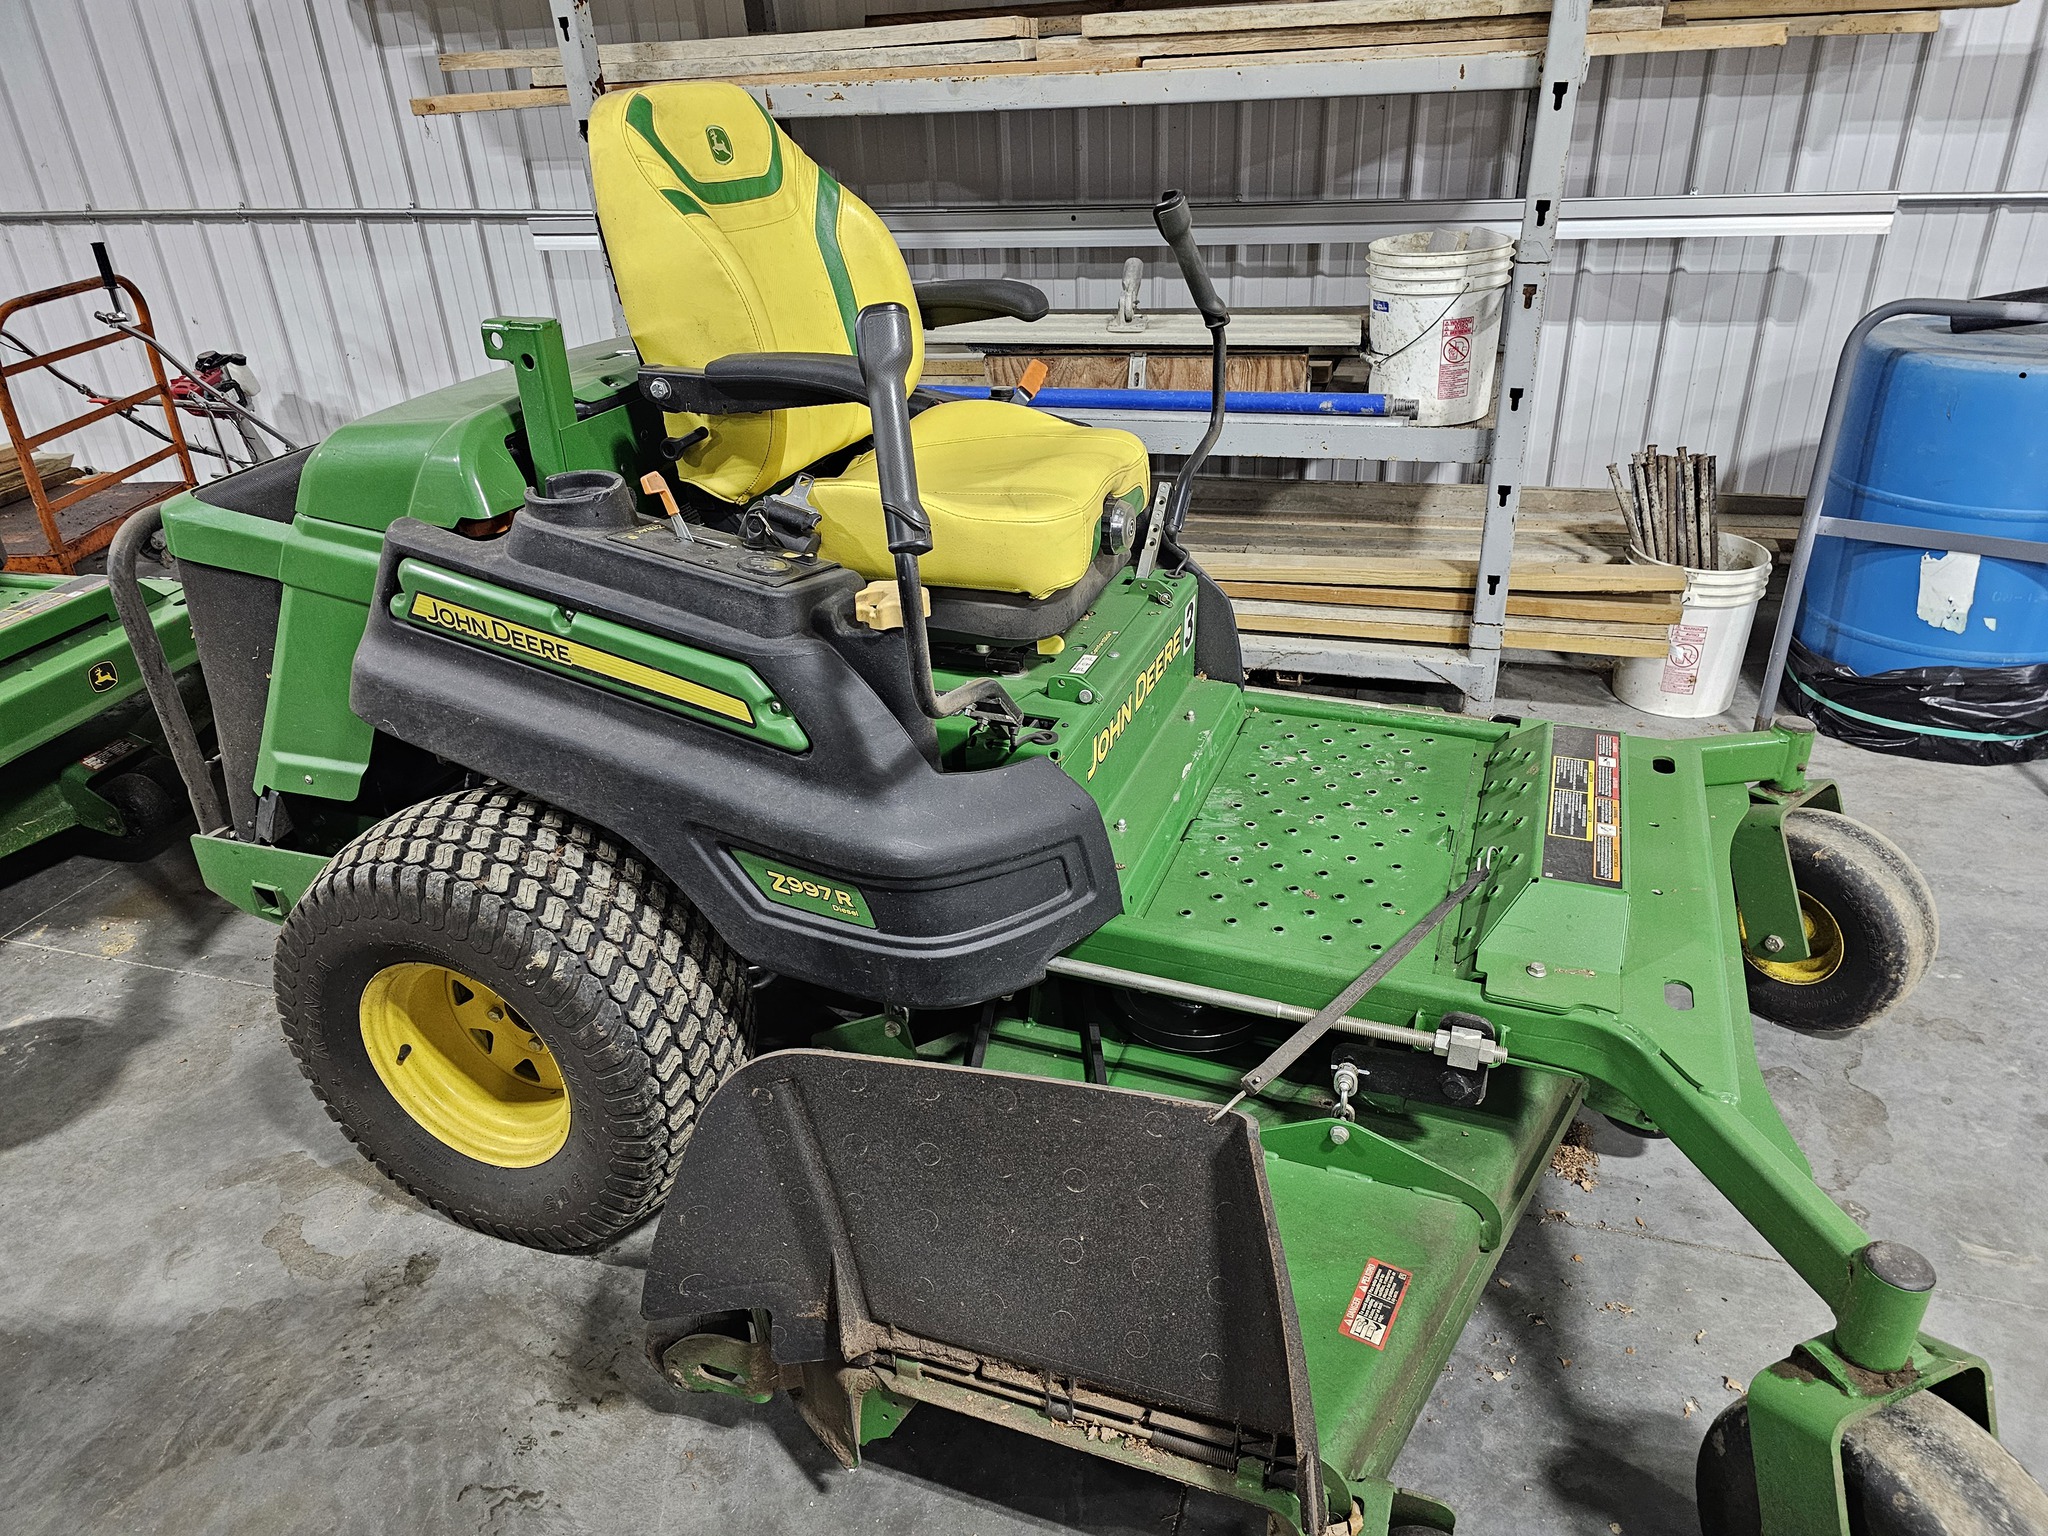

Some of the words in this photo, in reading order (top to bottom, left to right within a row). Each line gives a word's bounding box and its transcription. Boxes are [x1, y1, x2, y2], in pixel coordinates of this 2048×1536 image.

[428, 601, 489, 637] JOHN
[491, 619, 572, 663] DEERE
[1184, 600, 1194, 648] 3
[1086, 691, 1133, 783] JOHN
[1134, 622, 1182, 714] DEERE
[831, 904, 860, 917] Diesel
[304, 958, 332, 1060] KENDA
